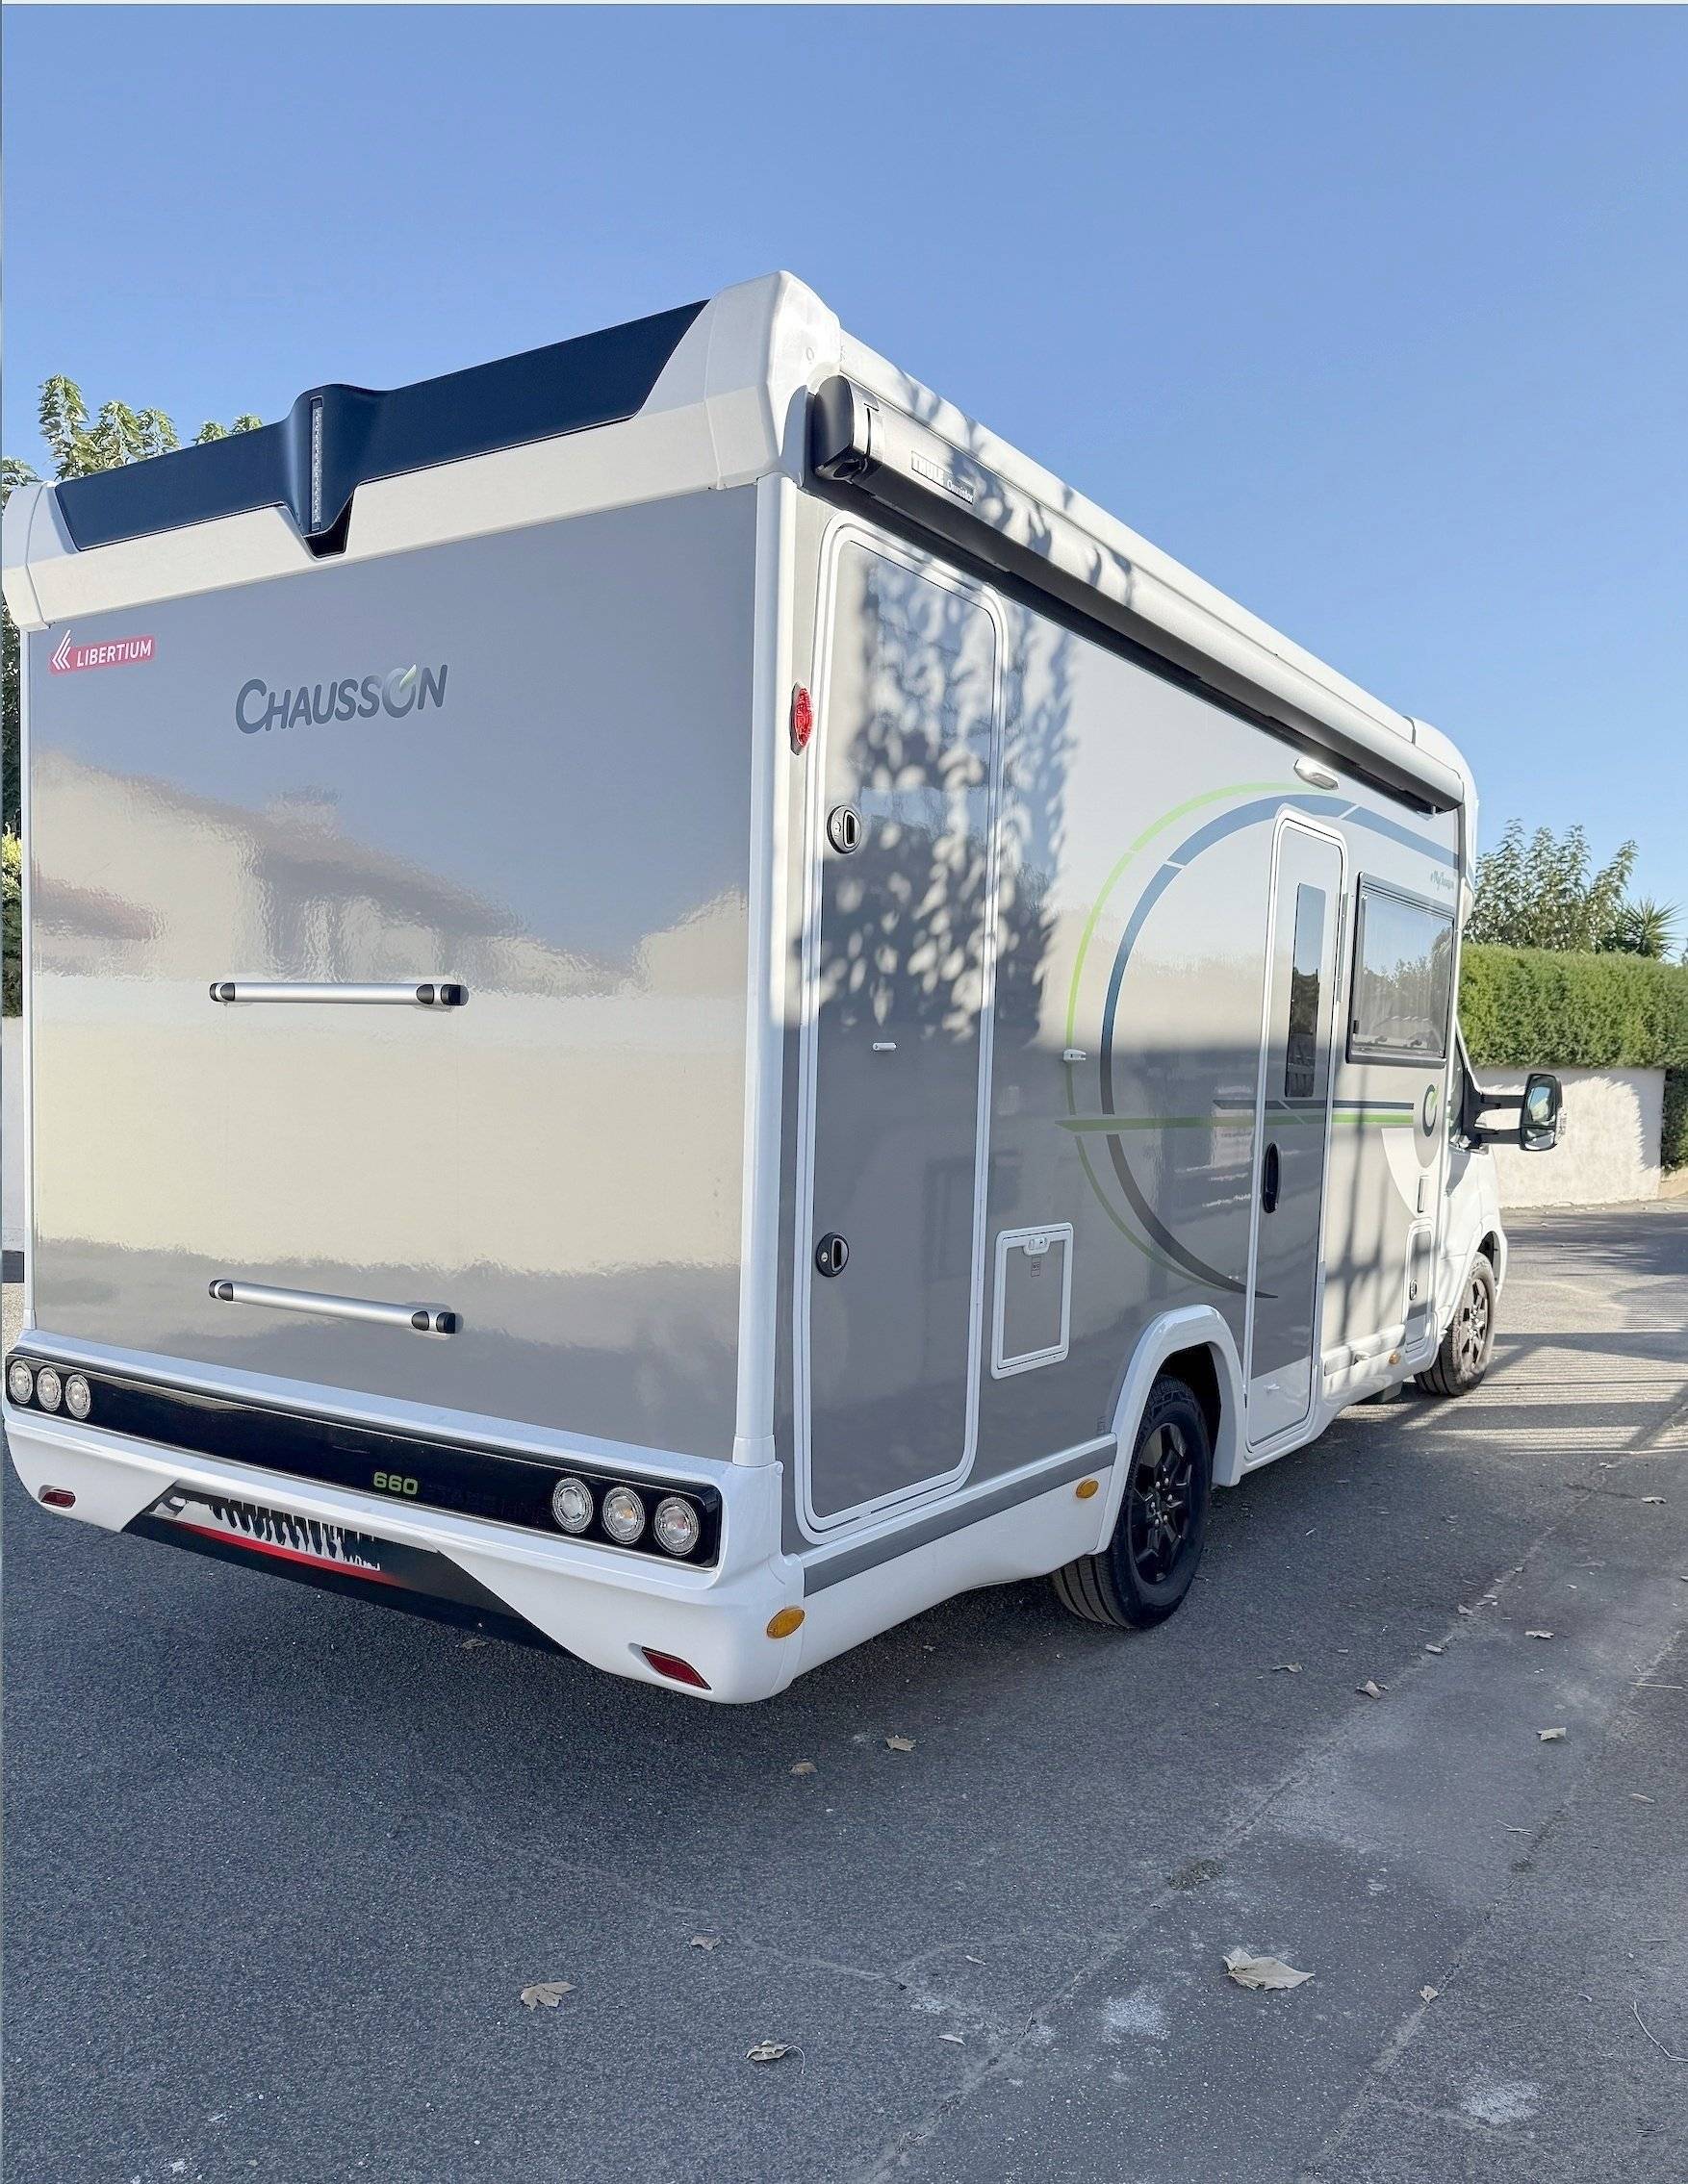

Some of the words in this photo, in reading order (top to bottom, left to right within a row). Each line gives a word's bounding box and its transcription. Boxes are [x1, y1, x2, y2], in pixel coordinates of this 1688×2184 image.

[76, 639, 152, 668] LIBERTIUM
[235, 664, 448, 734] CHAUSSON
[372, 1471, 419, 1495] 660
